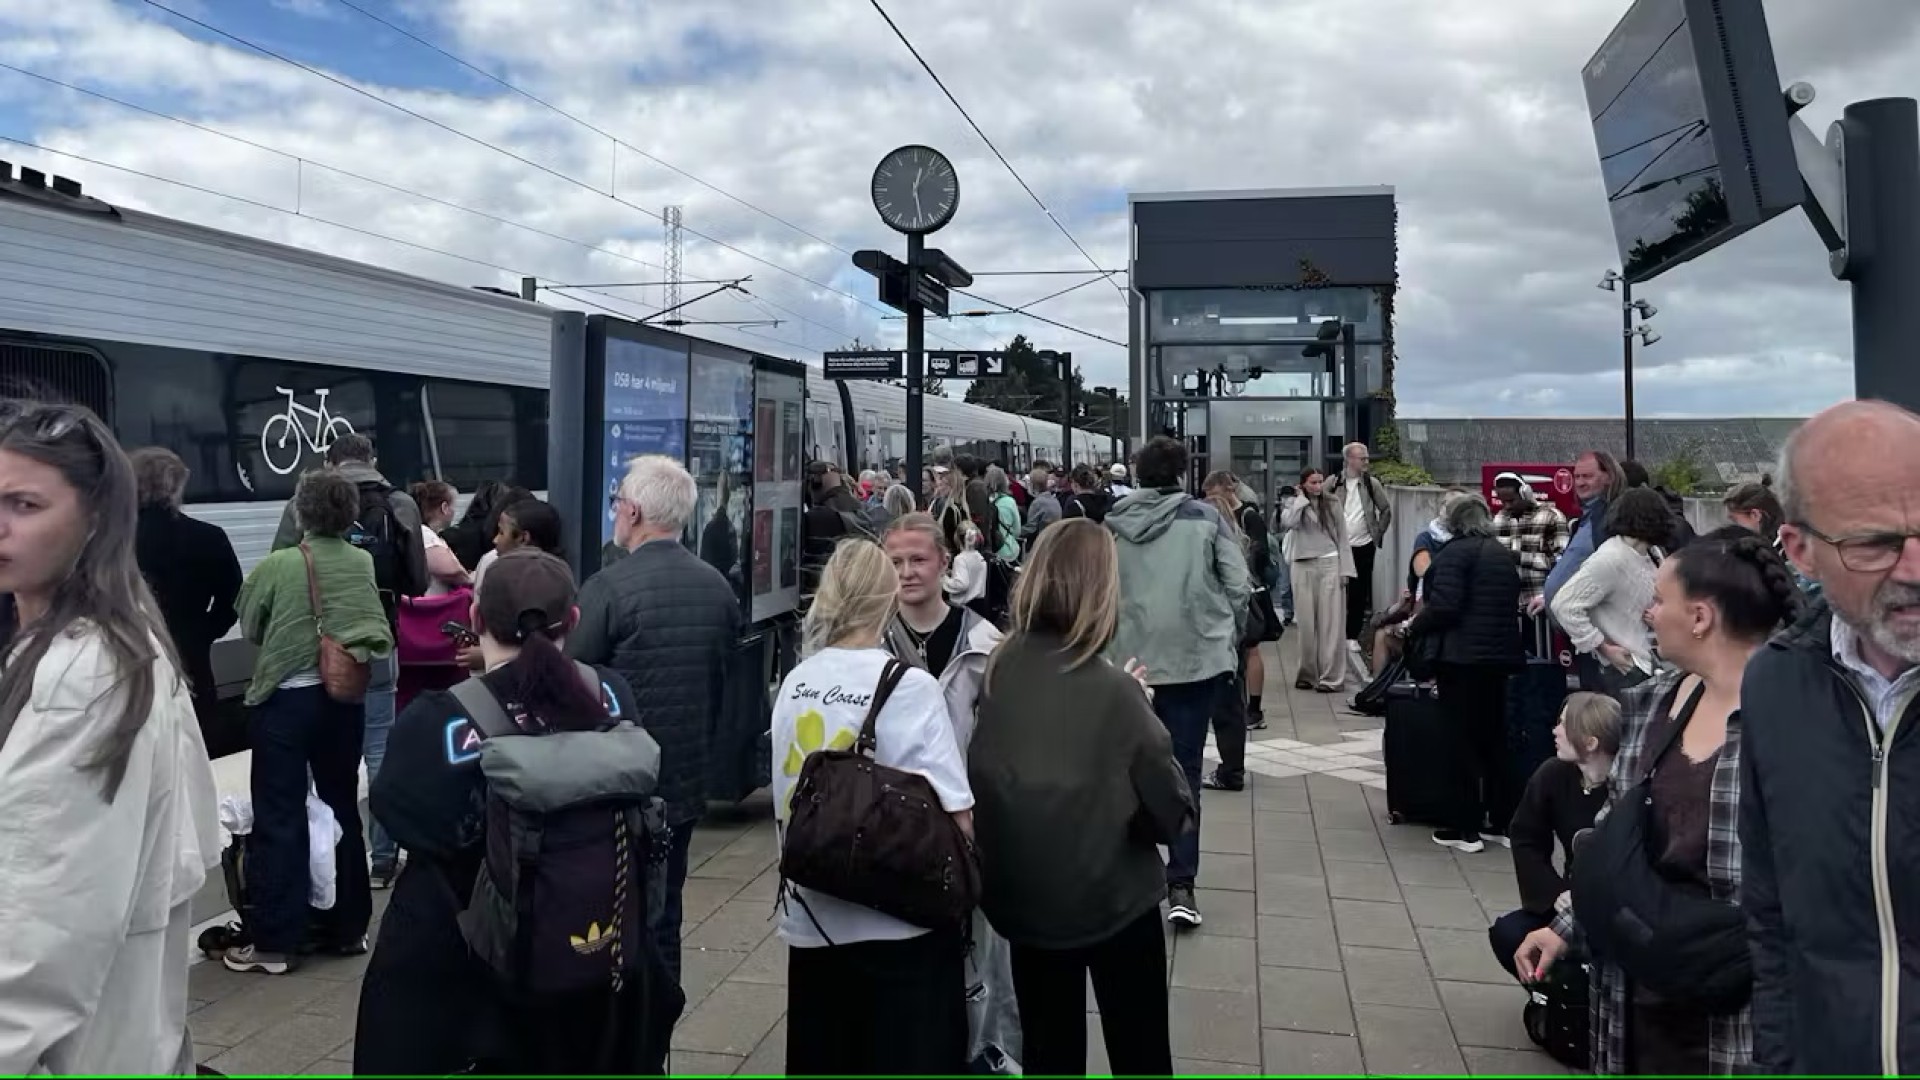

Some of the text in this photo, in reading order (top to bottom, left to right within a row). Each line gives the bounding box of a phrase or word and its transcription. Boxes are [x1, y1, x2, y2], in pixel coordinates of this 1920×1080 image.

[614, 371, 630, 388] DSB
[791, 682, 872, 707] Sun Coast
